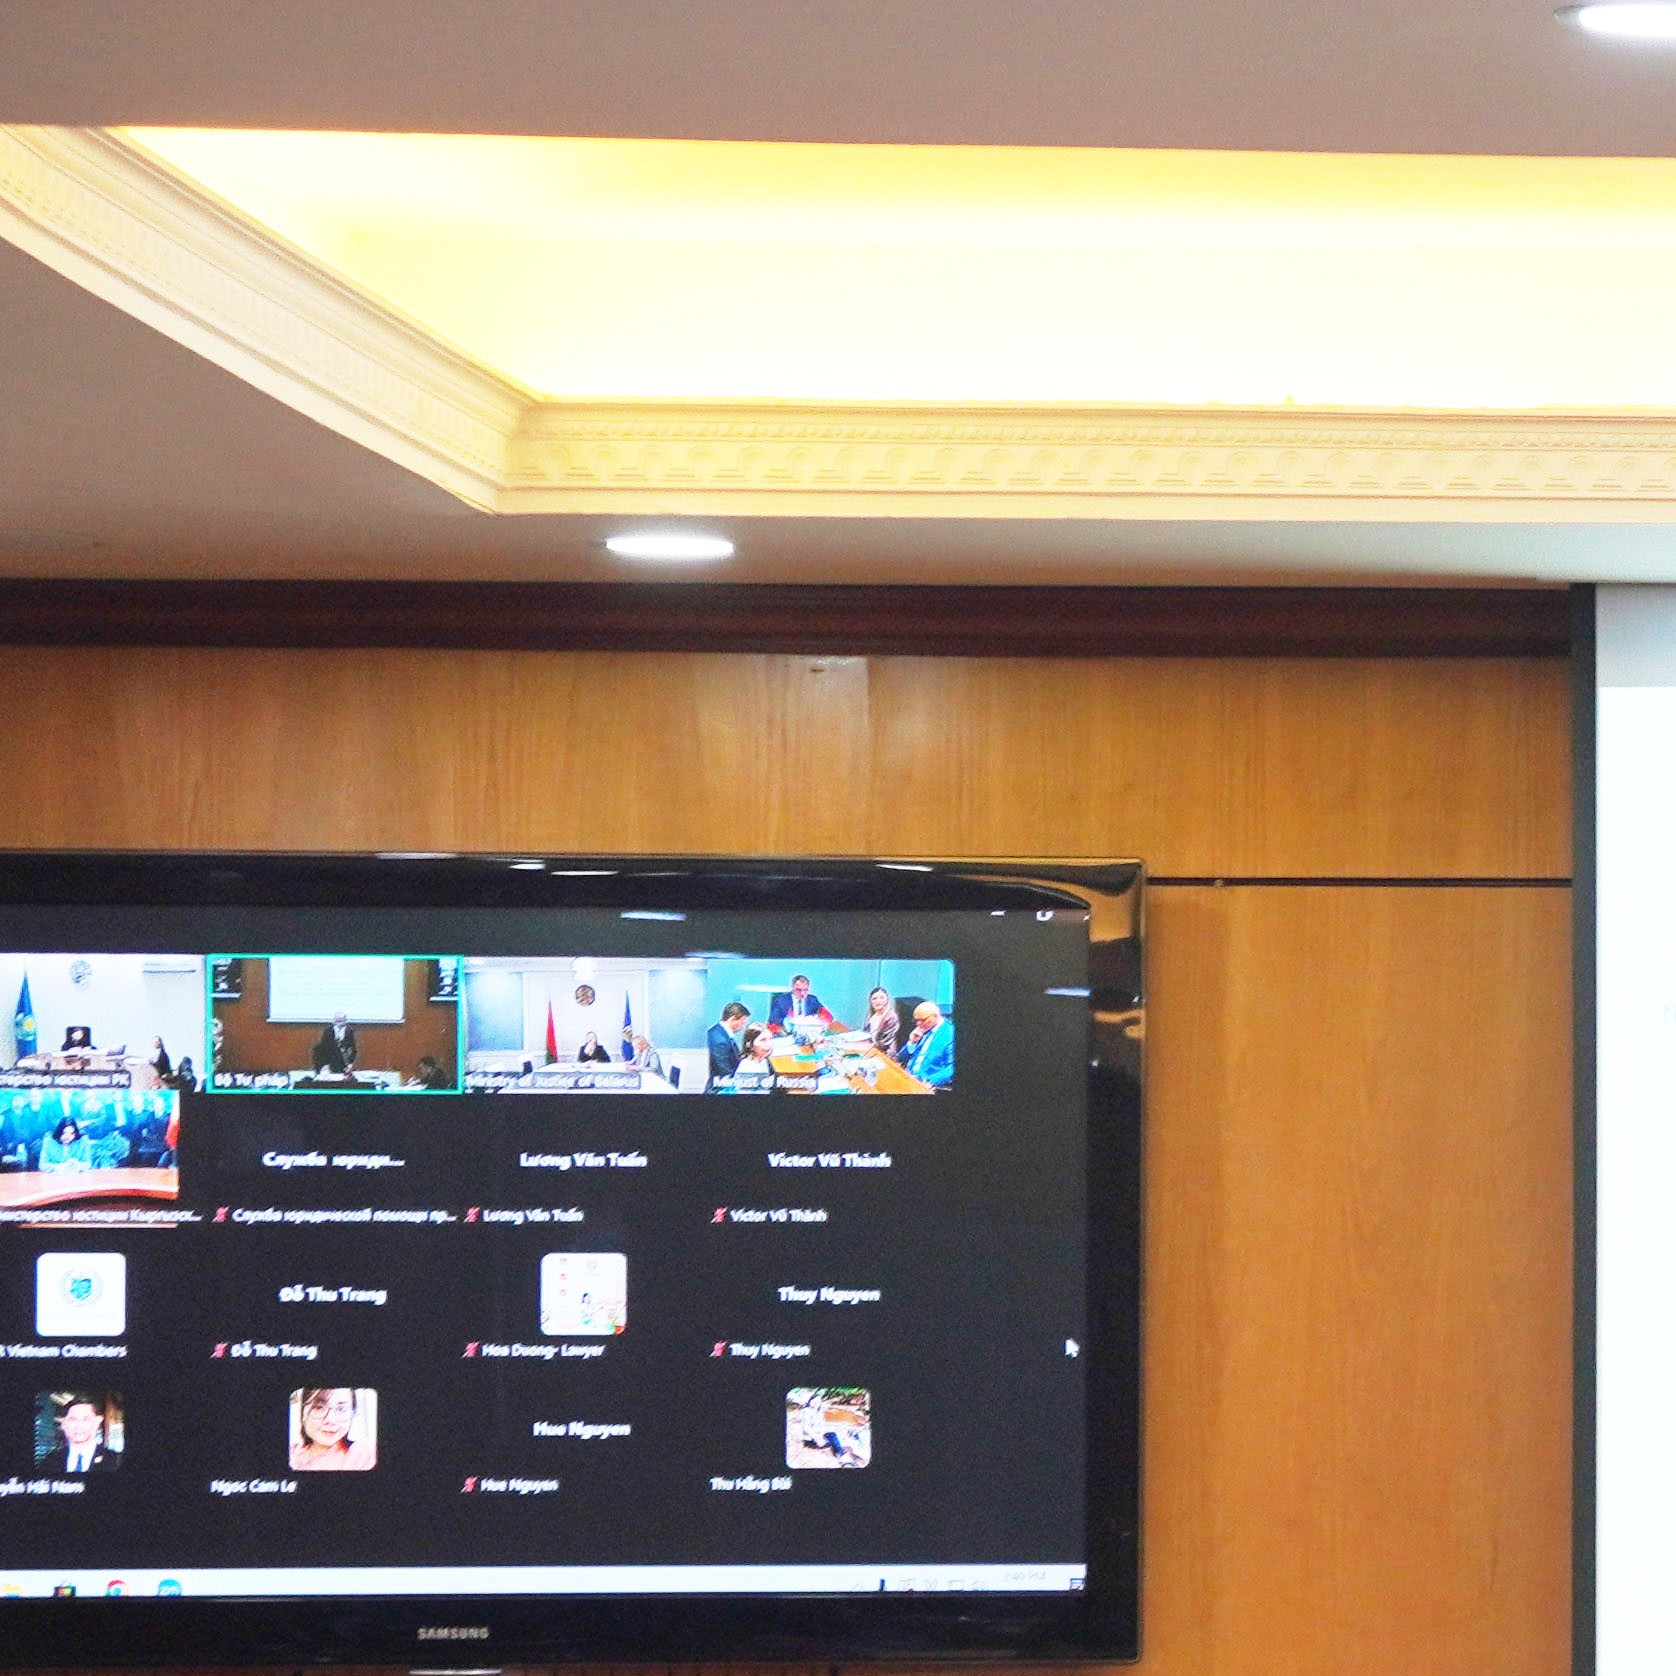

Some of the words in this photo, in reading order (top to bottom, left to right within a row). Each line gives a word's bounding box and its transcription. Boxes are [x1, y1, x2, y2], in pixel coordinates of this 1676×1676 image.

[768, 1152, 815, 1167] Victor
[730, 1208, 768, 1222] Victor
[305, 1286, 338, 1302] Thu
[338, 1287, 387, 1305] Trang
[778, 1286, 818, 1304] Thuy
[820, 1287, 881, 1305] Nguyen
[7, 1343, 60, 1357] Vietnam
[61, 1344, 127, 1357] Chambers
[254, 1344, 279, 1357] Thu
[280, 1344, 318, 1360] Trang
[557, 1344, 606, 1359] Lawyer
[729, 1343, 760, 1359] Thuy
[761, 1343, 811, 1359] Nguyen
[568, 1421, 631, 1439] Nguyen
[509, 1478, 559, 1494] Nguyen
[710, 1477, 736, 1490] Thu
[418, 1627, 489, 1640] SAMSUNG
